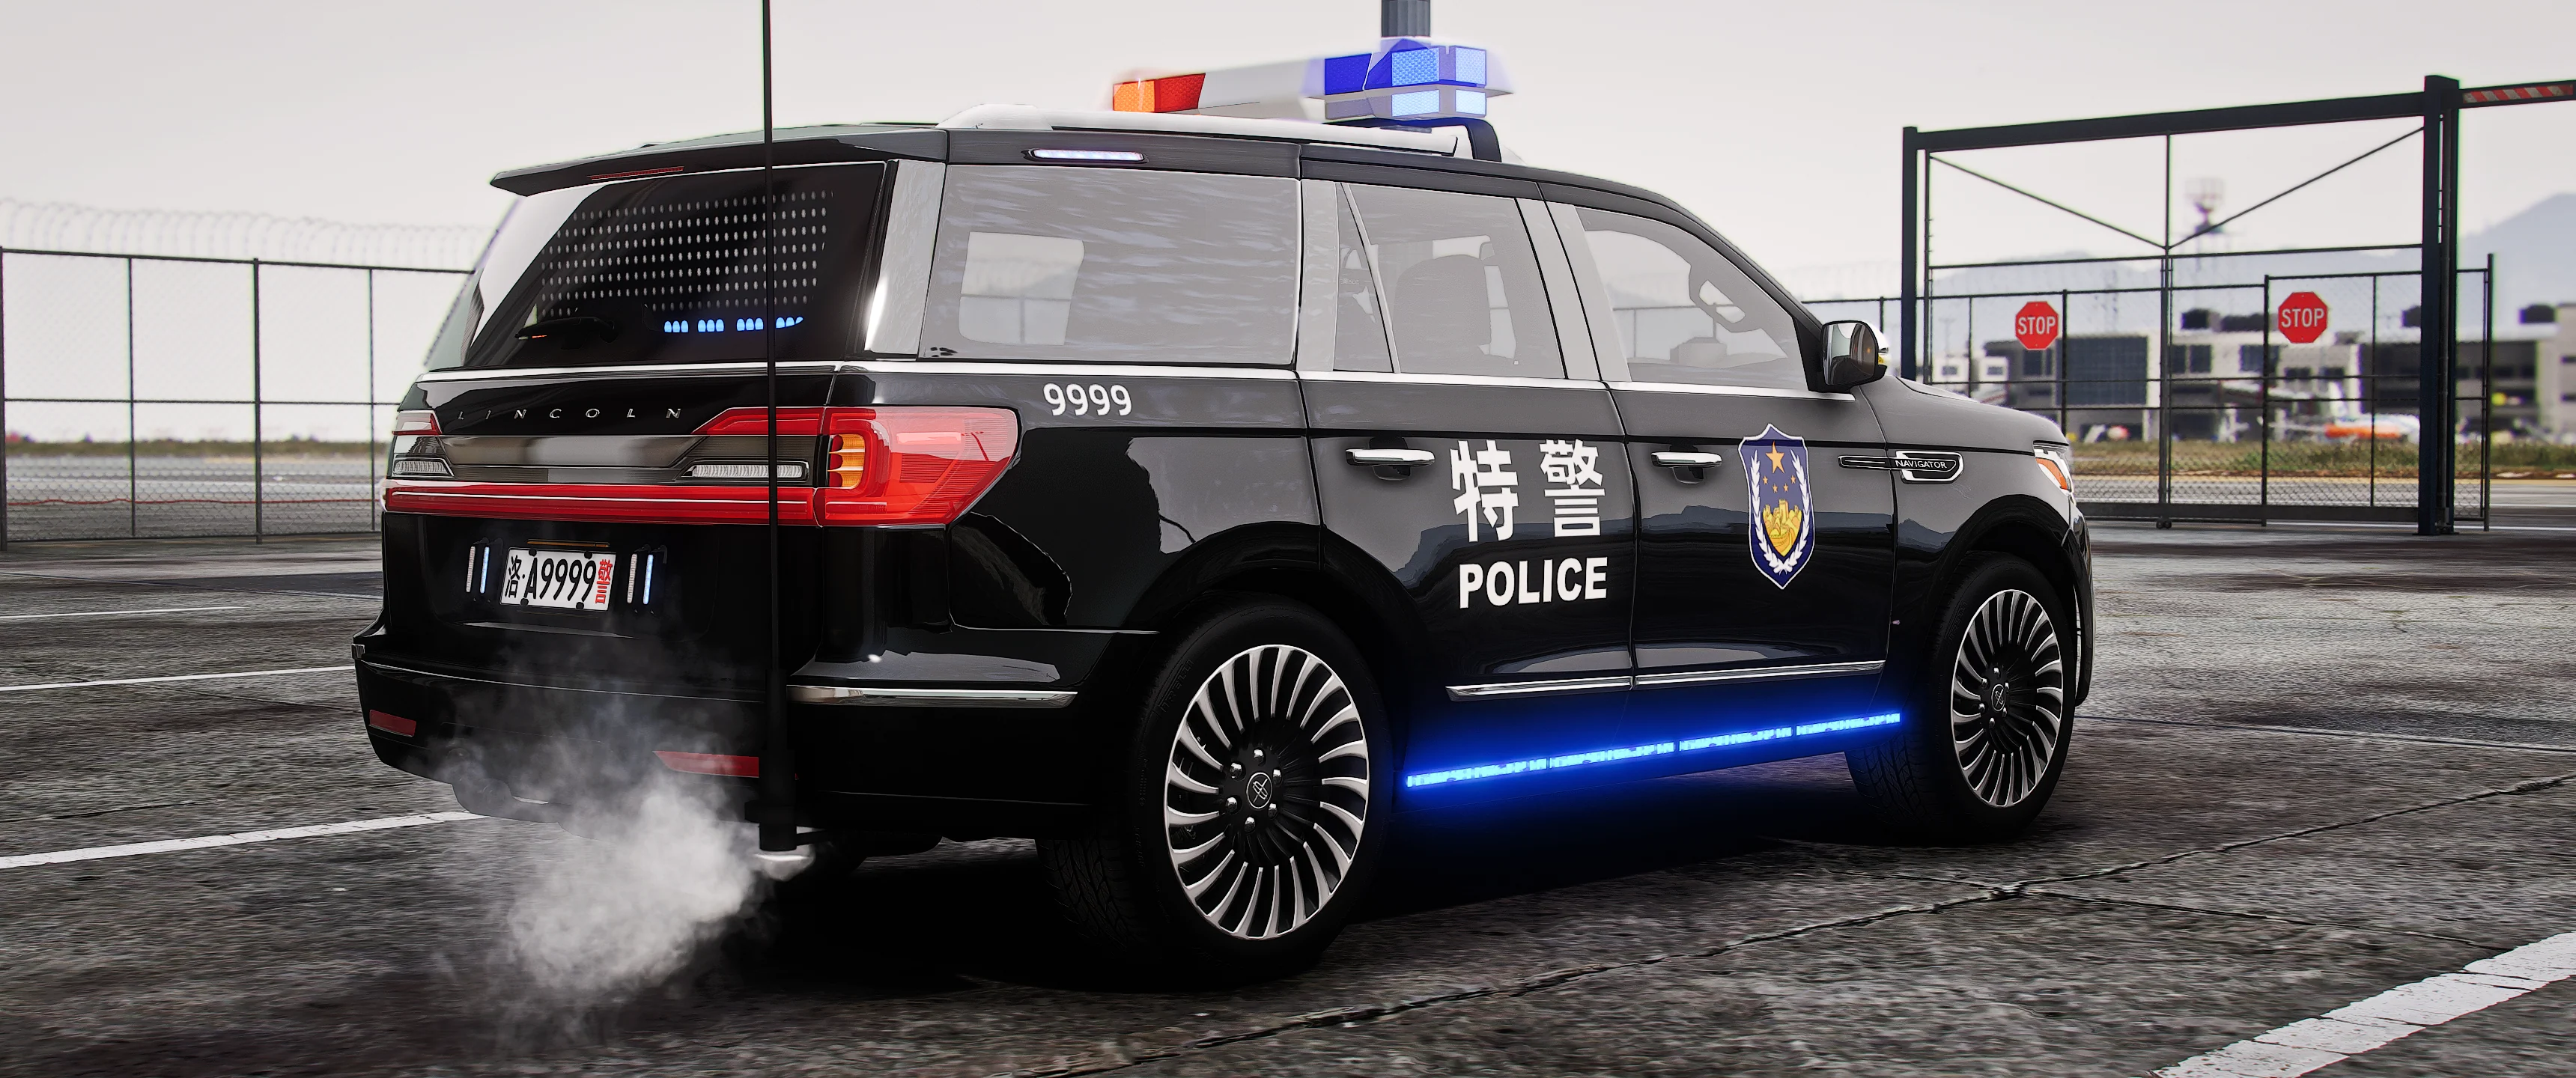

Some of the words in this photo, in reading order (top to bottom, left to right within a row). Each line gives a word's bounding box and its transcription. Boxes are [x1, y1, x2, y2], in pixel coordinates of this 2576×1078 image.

[2017, 316, 2056, 335] STOP
[2281, 308, 2324, 328] STOP
[1043, 383, 1132, 416] 9999
[458, 408, 681, 420] LINCOLN
[1895, 460, 1948, 469] NAVIGATOR
[1450, 439, 1606, 543] 特警
[1459, 557, 1608, 609] POLICE
